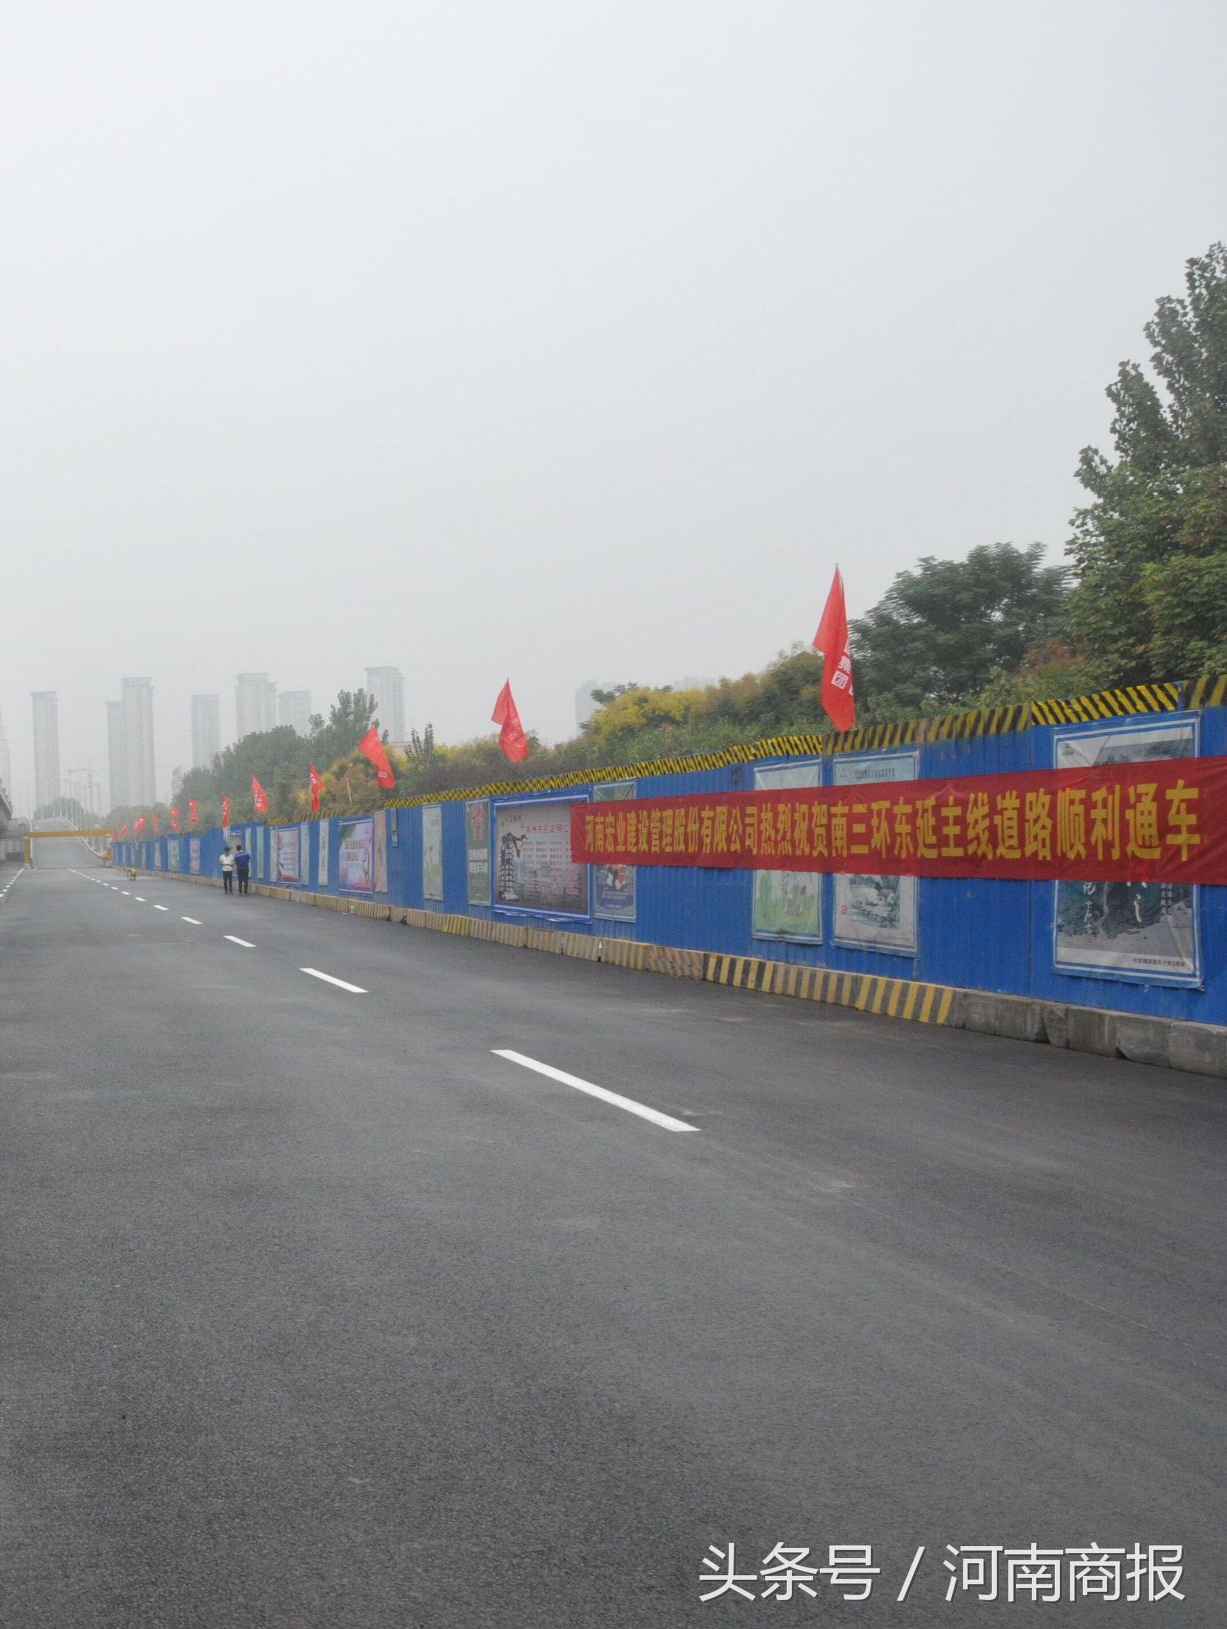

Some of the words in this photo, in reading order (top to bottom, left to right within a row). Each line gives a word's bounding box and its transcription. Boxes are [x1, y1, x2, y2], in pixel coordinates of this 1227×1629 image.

[585, 779, 1201, 862] 河南宏业建设管理股份有限公司热烈祝贺南三环东延主线道路顺利通车
